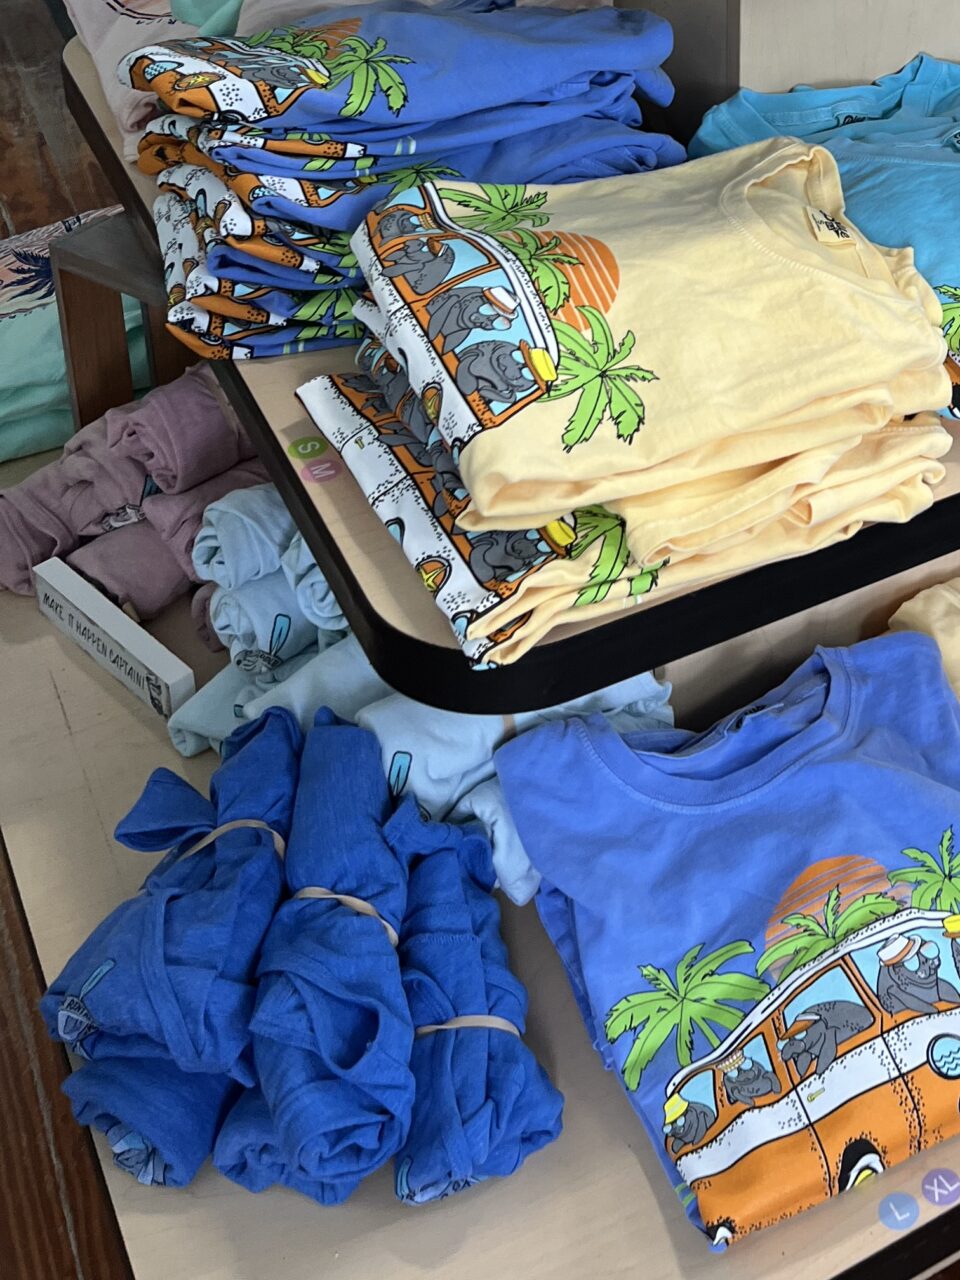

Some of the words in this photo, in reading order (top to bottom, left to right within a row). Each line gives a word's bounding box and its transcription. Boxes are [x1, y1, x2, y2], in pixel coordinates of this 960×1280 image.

[298, 441, 320, 454] S
[310, 462, 336, 479] M
[42, 592, 64, 621] MAKE
[75, 622, 108, 658] HAPPEN
[888, 1201, 911, 1221] L
[924, 1174, 960, 1203] XL
